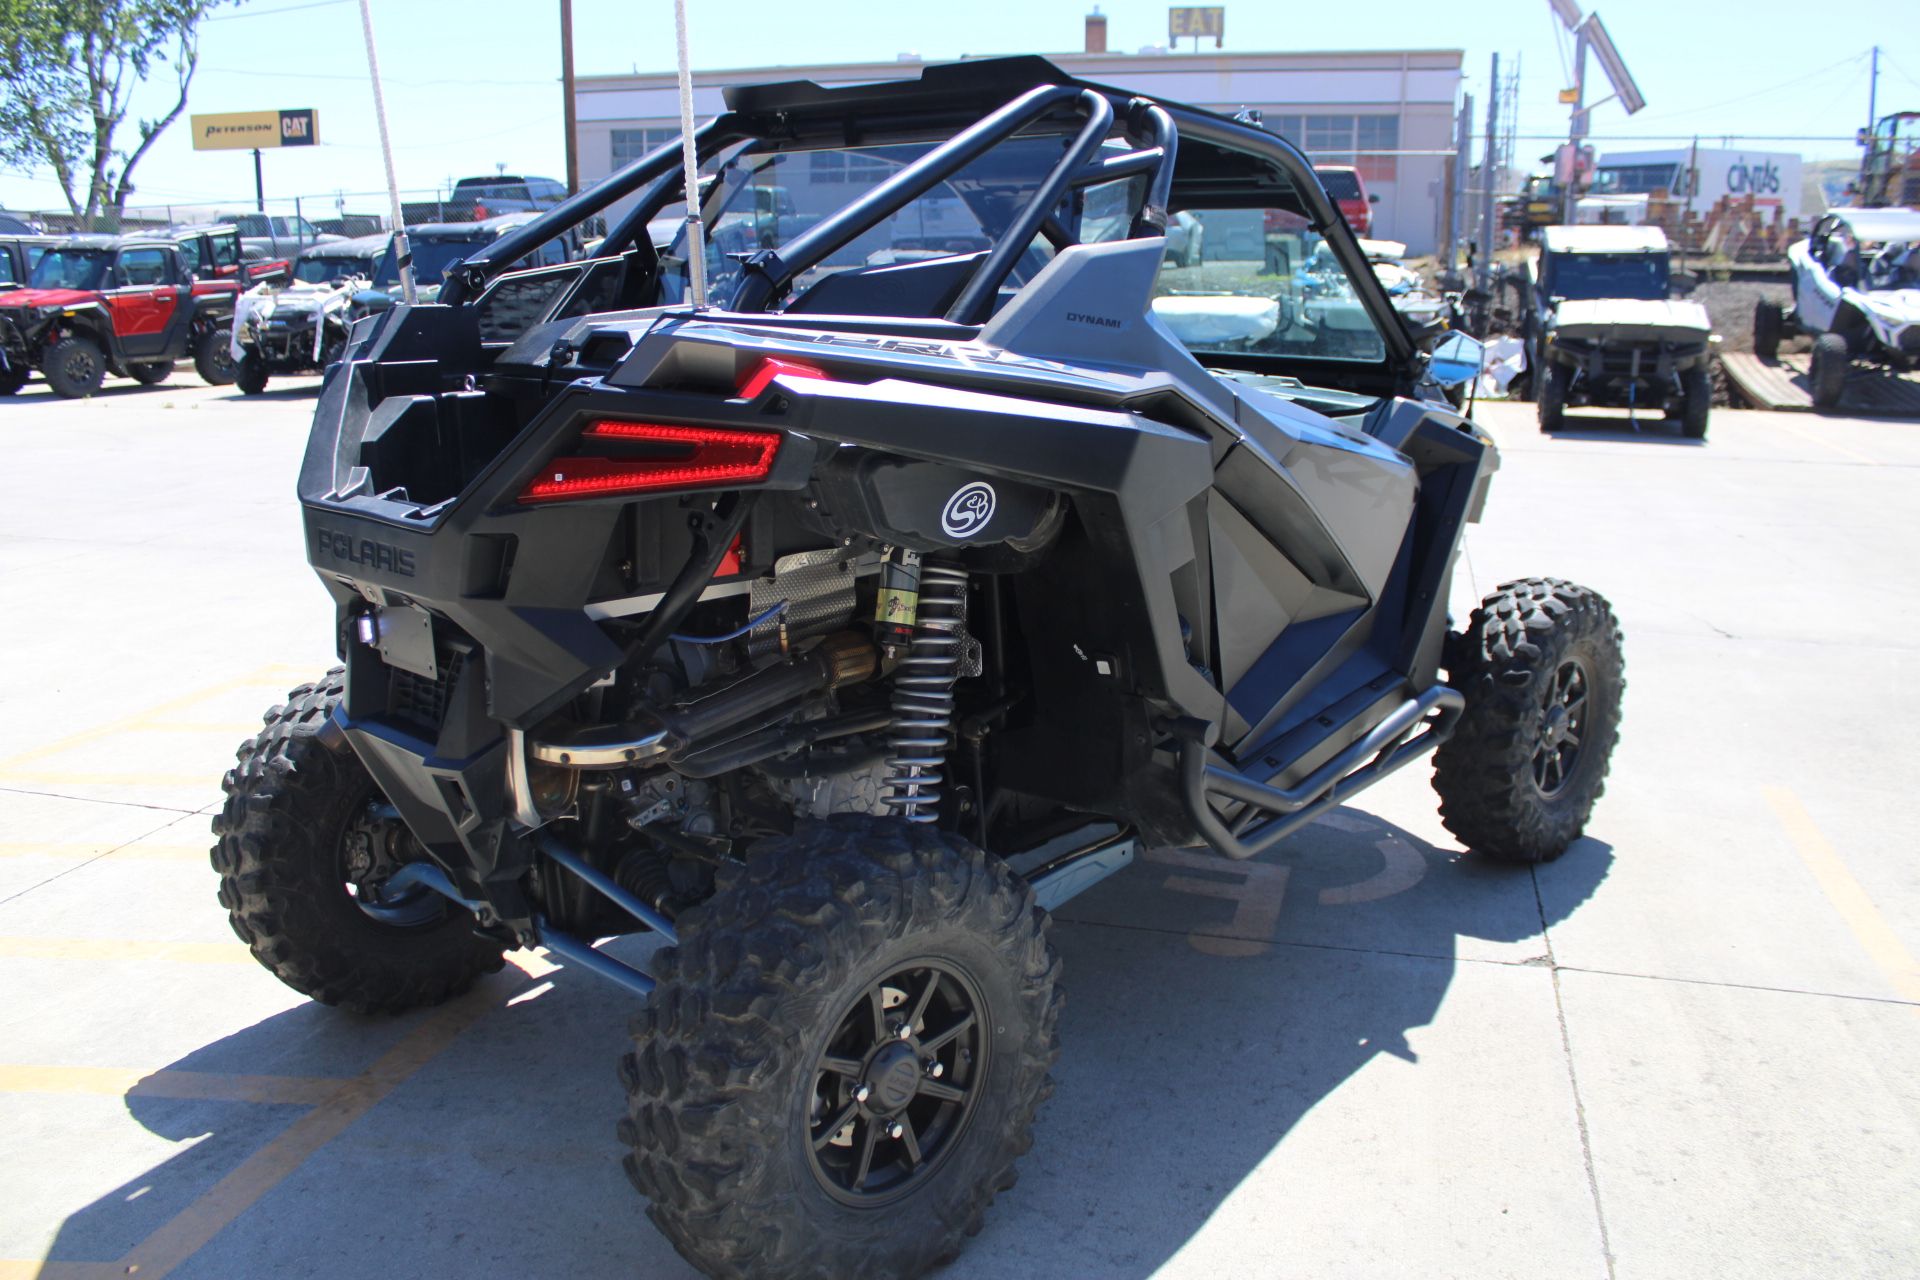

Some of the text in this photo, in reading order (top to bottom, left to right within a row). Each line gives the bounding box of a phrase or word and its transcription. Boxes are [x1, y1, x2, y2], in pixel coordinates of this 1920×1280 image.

[1172, 8, 1222, 33] EAT
[206, 123, 272, 138] PETERSON
[282, 117, 308, 138] CAT
[1727, 155, 1779, 194] CINTAS
[1066, 312, 1128, 329] DYNAMI
[318, 527, 416, 577] POLARIS
